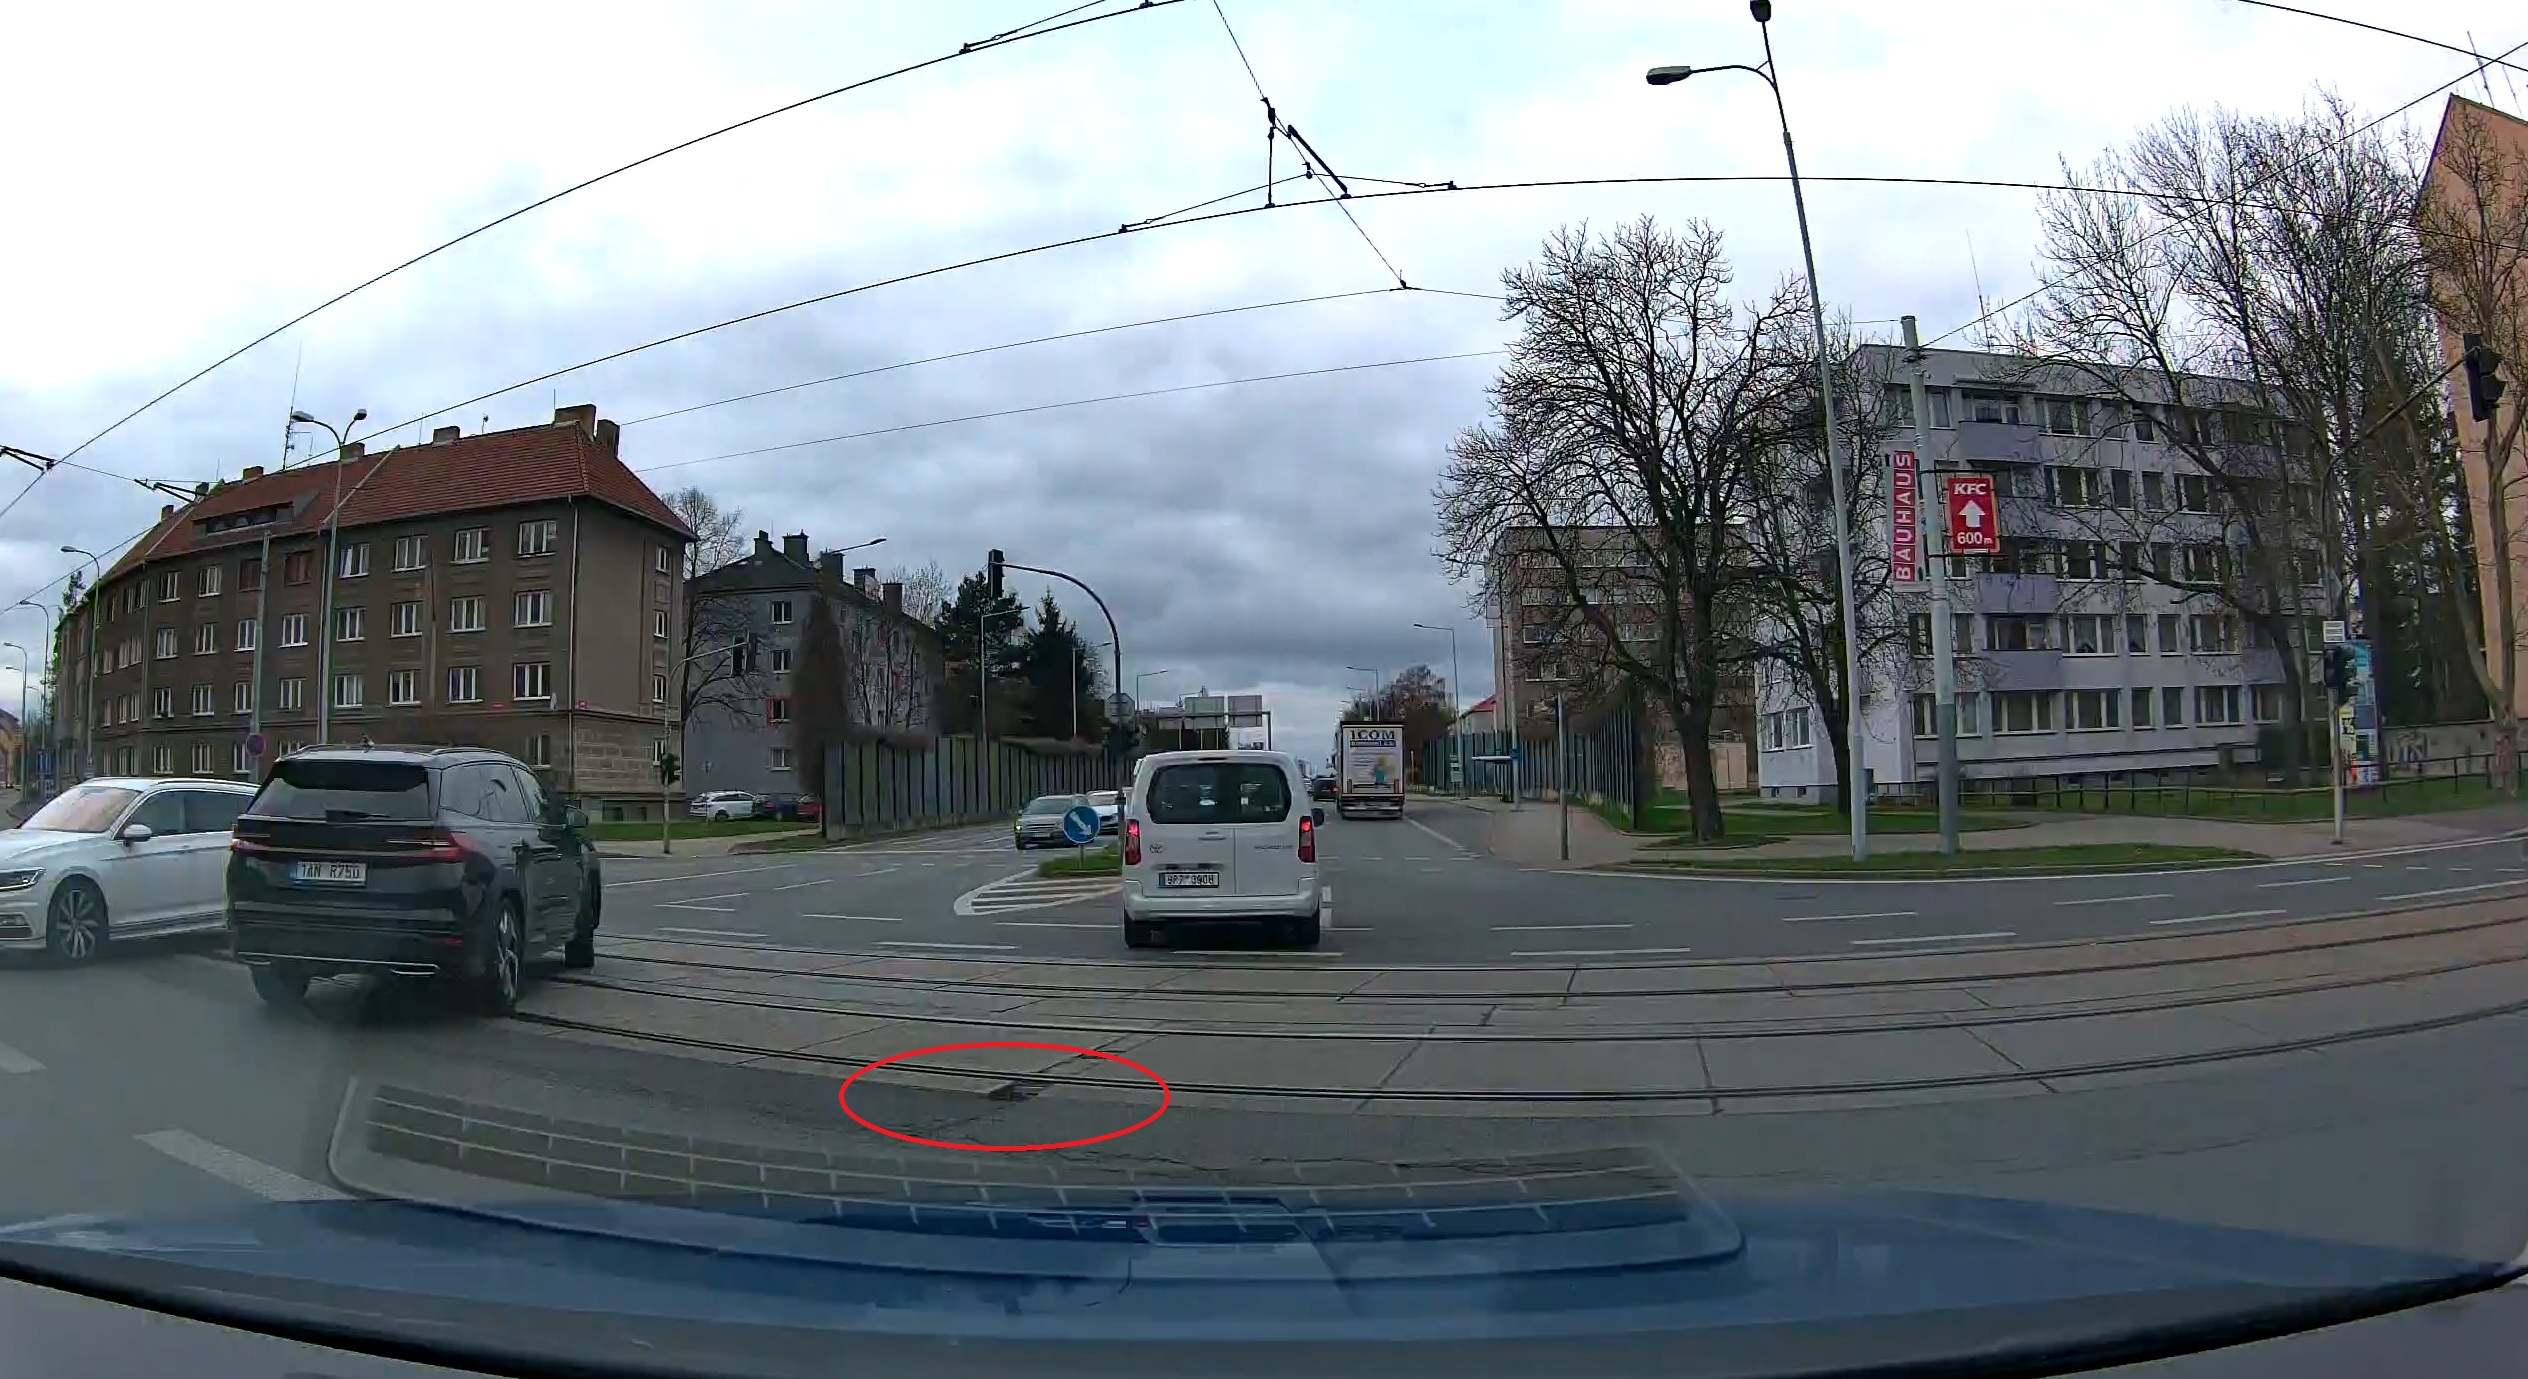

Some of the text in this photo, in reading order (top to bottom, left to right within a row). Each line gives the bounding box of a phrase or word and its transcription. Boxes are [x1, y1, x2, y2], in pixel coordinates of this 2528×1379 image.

[1953, 483, 1987, 495] KFC
[1896, 454, 1912, 580] BAUHAUS
[1957, 532, 1982, 544] 600
[1350, 729, 1395, 740] ICOM
